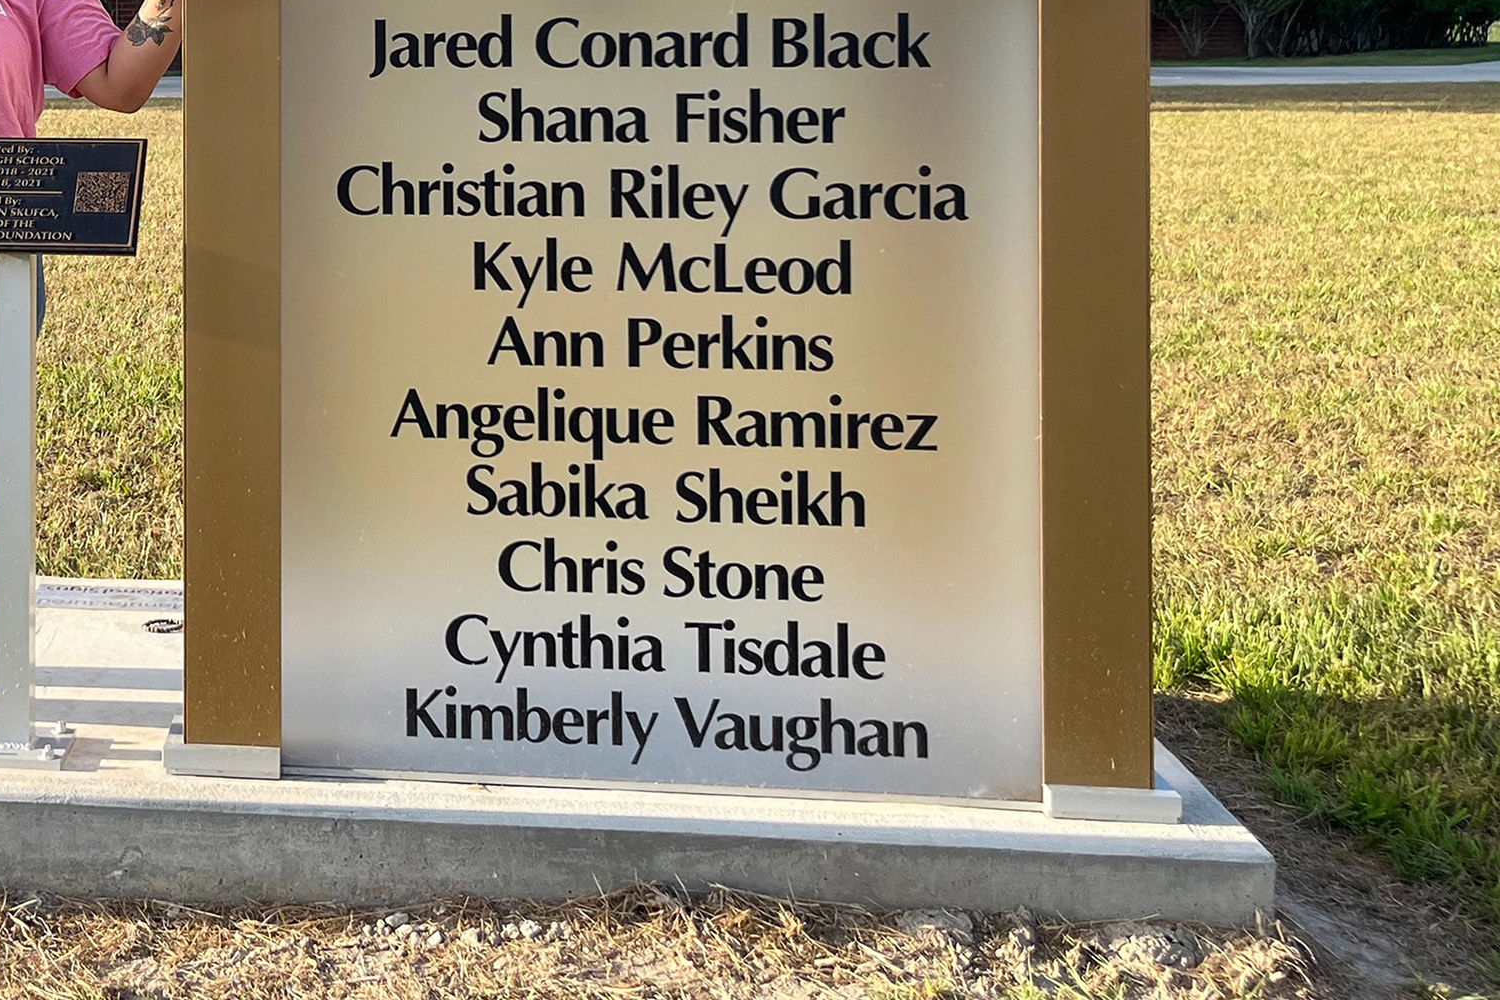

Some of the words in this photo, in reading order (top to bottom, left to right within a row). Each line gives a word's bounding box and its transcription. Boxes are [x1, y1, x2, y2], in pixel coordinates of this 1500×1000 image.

[369, 13, 513, 79] Jared
[535, 12, 749, 69] Conard
[771, 12, 931, 69] Black
[477, 88, 648, 144] Shana
[675, 88, 845, 144] Fisher
[16, 156, 66, 165] SCHOOL
[17, 145, 35, 155] By:
[28, 167, 55, 176] 2021
[5, 196, 22, 206] By:
[15, 178, 41, 187] 2021
[336, 161, 585, 218] Christian
[610, 165, 748, 237] Riley
[769, 165, 968, 222] Garcia
[10, 207, 60, 219] SKUFCA,
[12, 218, 35, 228] THE
[473, 238, 593, 308] Kyle
[616, 239, 852, 296] McLeod
[487, 315, 604, 368] Ann
[627, 314, 833, 372] Perkins
[390, 387, 674, 460] Angelique
[696, 395, 938, 452] Ramirez
[466, 461, 649, 520] Sabika
[675, 470, 866, 527] Sheikh
[498, 537, 645, 596] Chris
[663, 545, 825, 602] Stone
[445, 613, 665, 683] Cynthia
[685, 620, 885, 680] Tisdale
[405, 685, 659, 765] Kimberly
[673, 697, 929, 771] Vaughan
